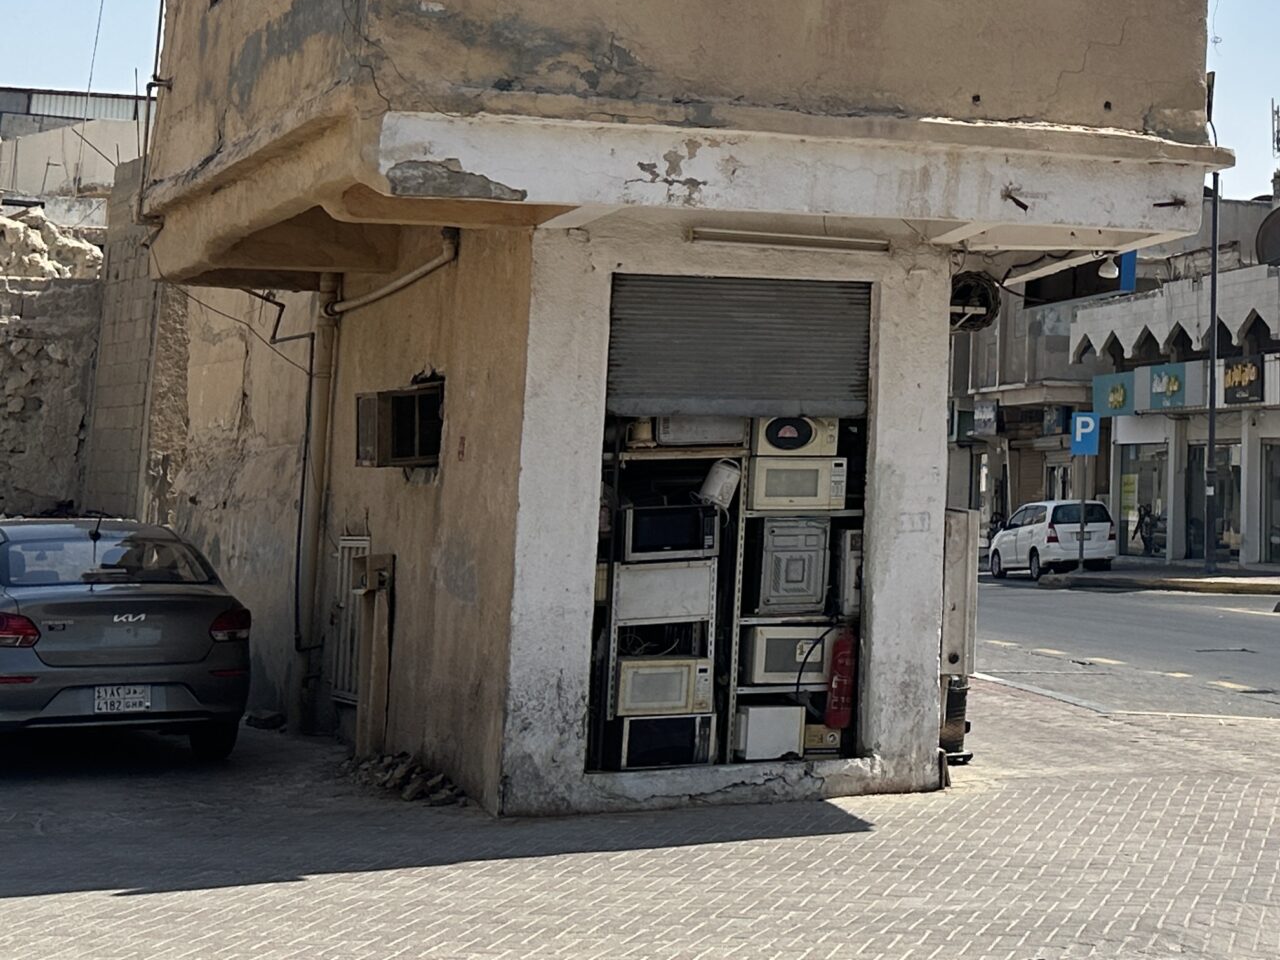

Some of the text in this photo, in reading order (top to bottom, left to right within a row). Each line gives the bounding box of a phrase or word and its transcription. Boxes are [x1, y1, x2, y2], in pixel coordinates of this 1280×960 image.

[1075, 416, 1095, 442] P
[113, 613, 146, 623] KIA
[96, 700, 122, 711] 4182
